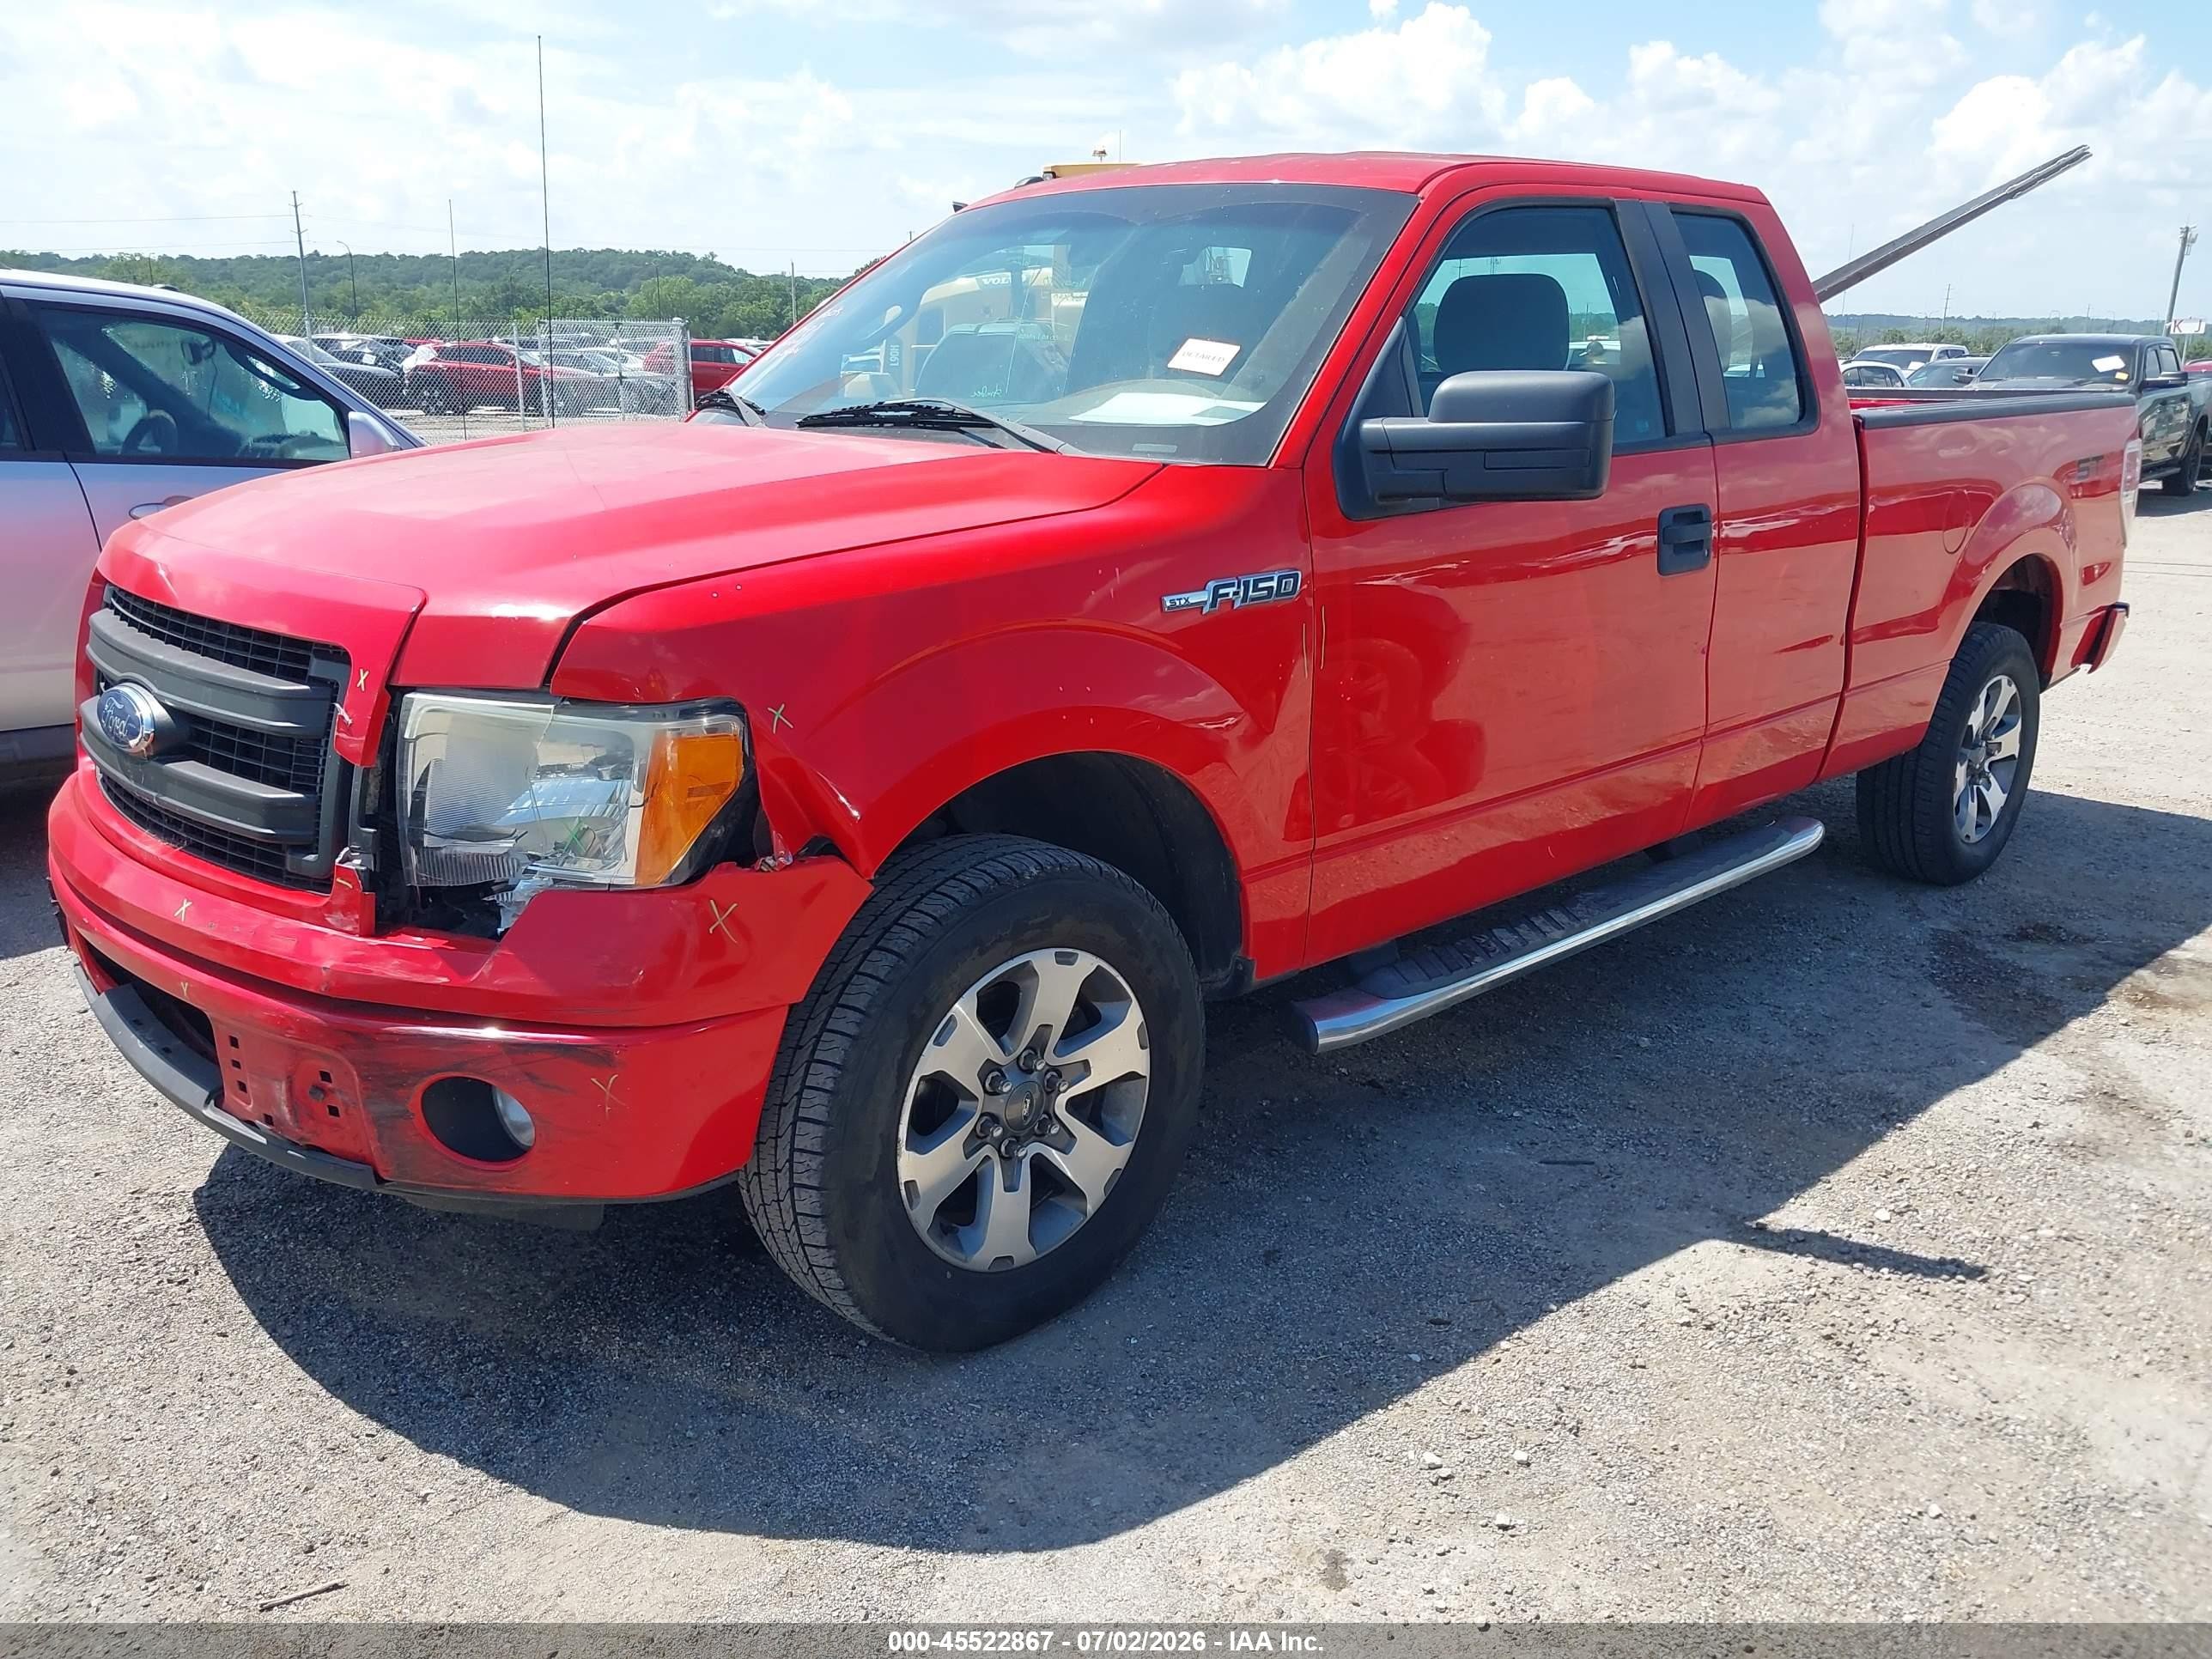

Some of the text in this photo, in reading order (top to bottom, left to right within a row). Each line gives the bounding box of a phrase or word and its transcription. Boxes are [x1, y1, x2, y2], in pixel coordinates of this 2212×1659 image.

[2172, 319, 2203, 333] K J
[890, 344, 900, 367] L90H
[1169, 568, 1301, 611] STX F-150
[103, 696, 136, 737] Ford
